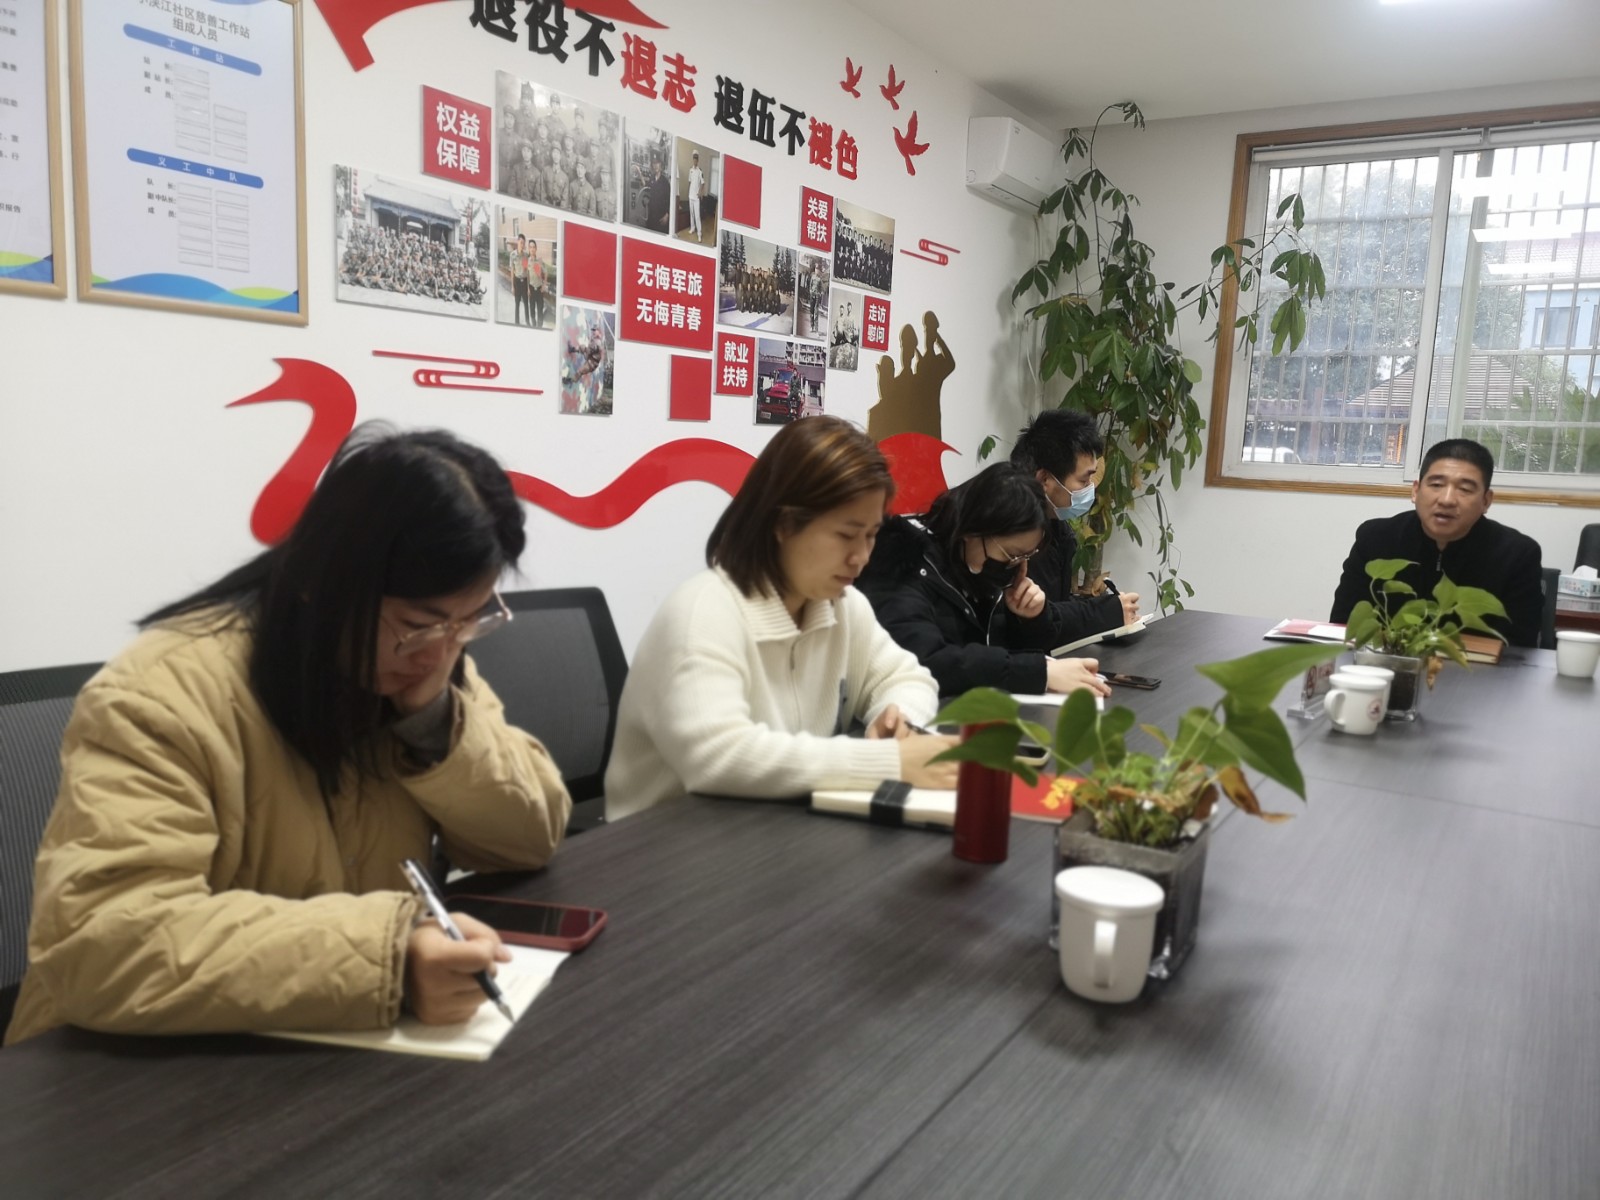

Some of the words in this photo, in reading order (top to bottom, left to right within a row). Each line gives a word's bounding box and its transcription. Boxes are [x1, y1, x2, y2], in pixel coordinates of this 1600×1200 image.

[172, 17, 218, 42] 组成人员
[167, 38, 224, 64] 工作站
[469, 0, 697, 113] 退役不退志
[714, 74, 859, 180] 退伍不褪色
[436, 101, 480, 142] 权益
[158, 156, 238, 182] 义工中队
[436, 137, 480, 175] 保障
[807, 195, 829, 221] 关爱
[806, 219, 828, 244] 帮扶
[636, 260, 704, 297] 无悔军旅
[636, 297, 702, 332] 无悔青春
[868, 303, 887, 323] 走访
[867, 324, 885, 343] 慰问
[723, 340, 750, 364] 就业
[722, 365, 748, 388] 扶持
